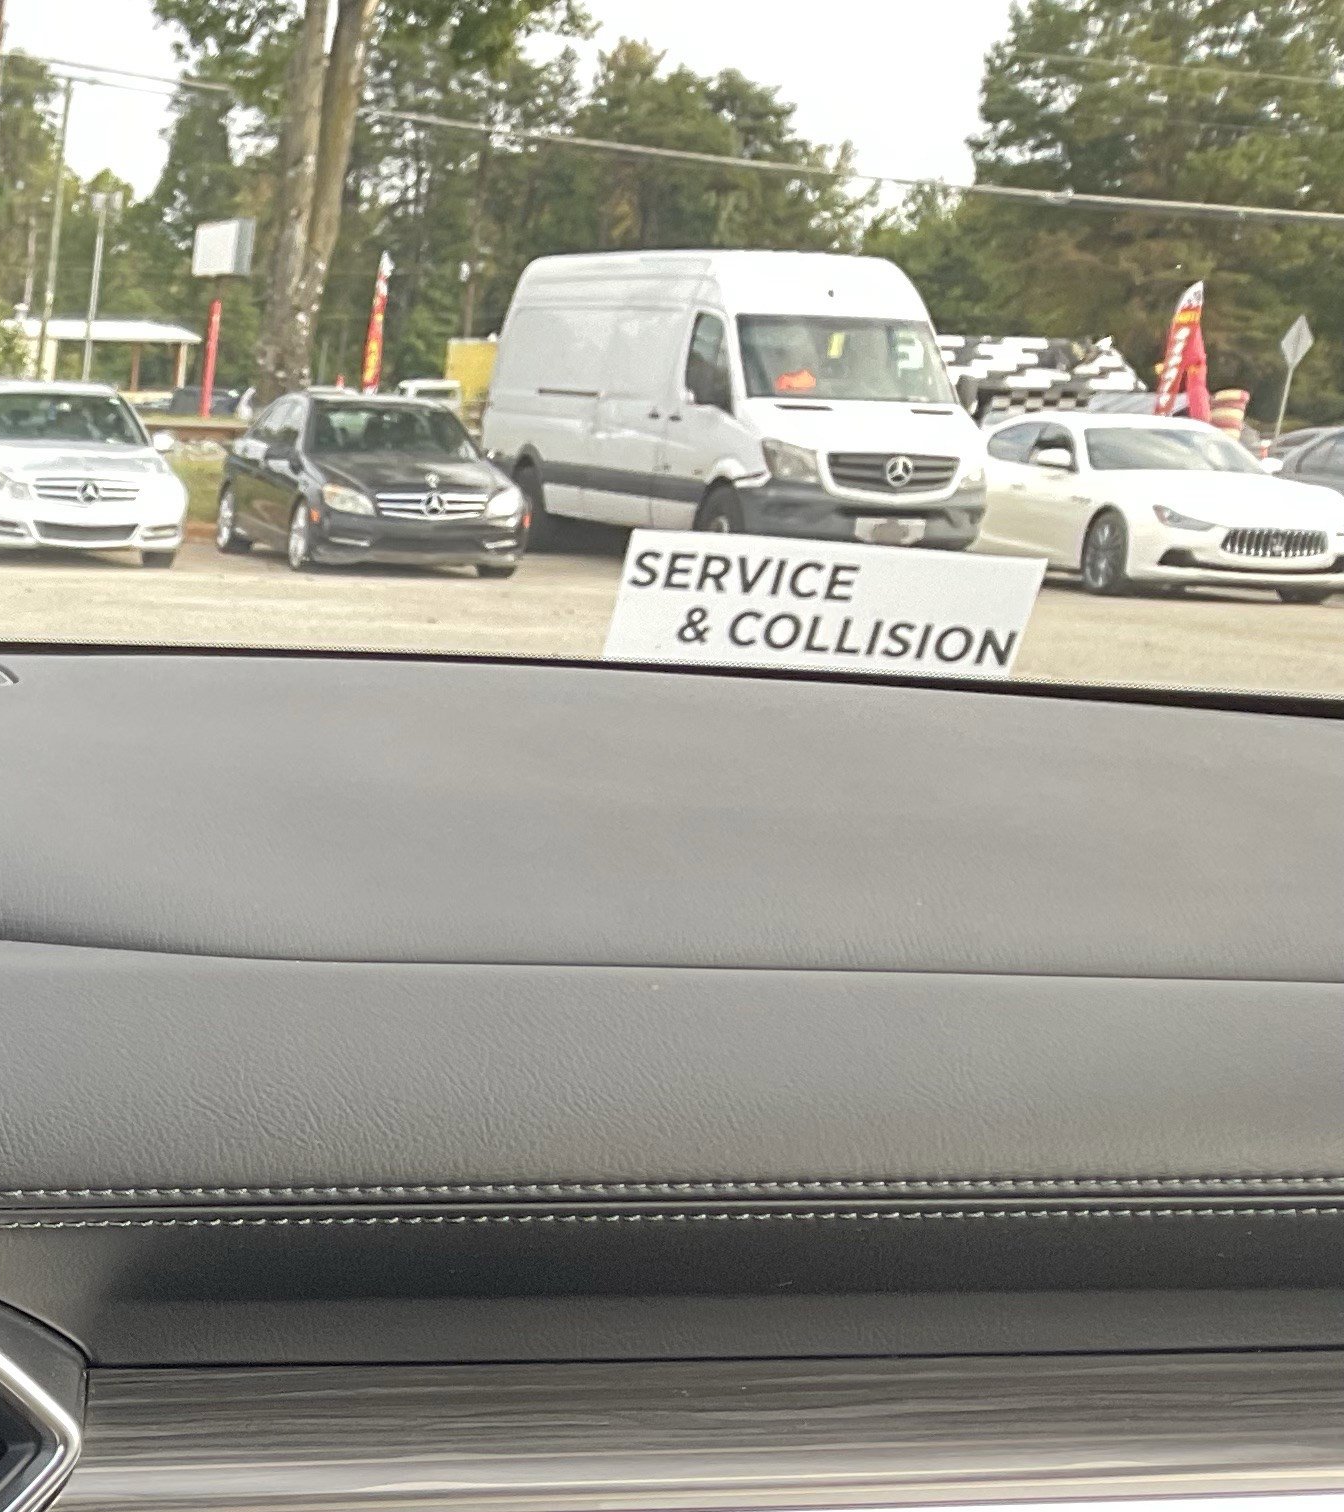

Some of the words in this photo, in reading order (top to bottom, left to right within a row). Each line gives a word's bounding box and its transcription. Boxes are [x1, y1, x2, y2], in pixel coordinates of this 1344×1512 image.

[628, 549, 861, 604] SERVICE
[676, 607, 710, 646] &
[726, 608, 1019, 668] COLLISION
